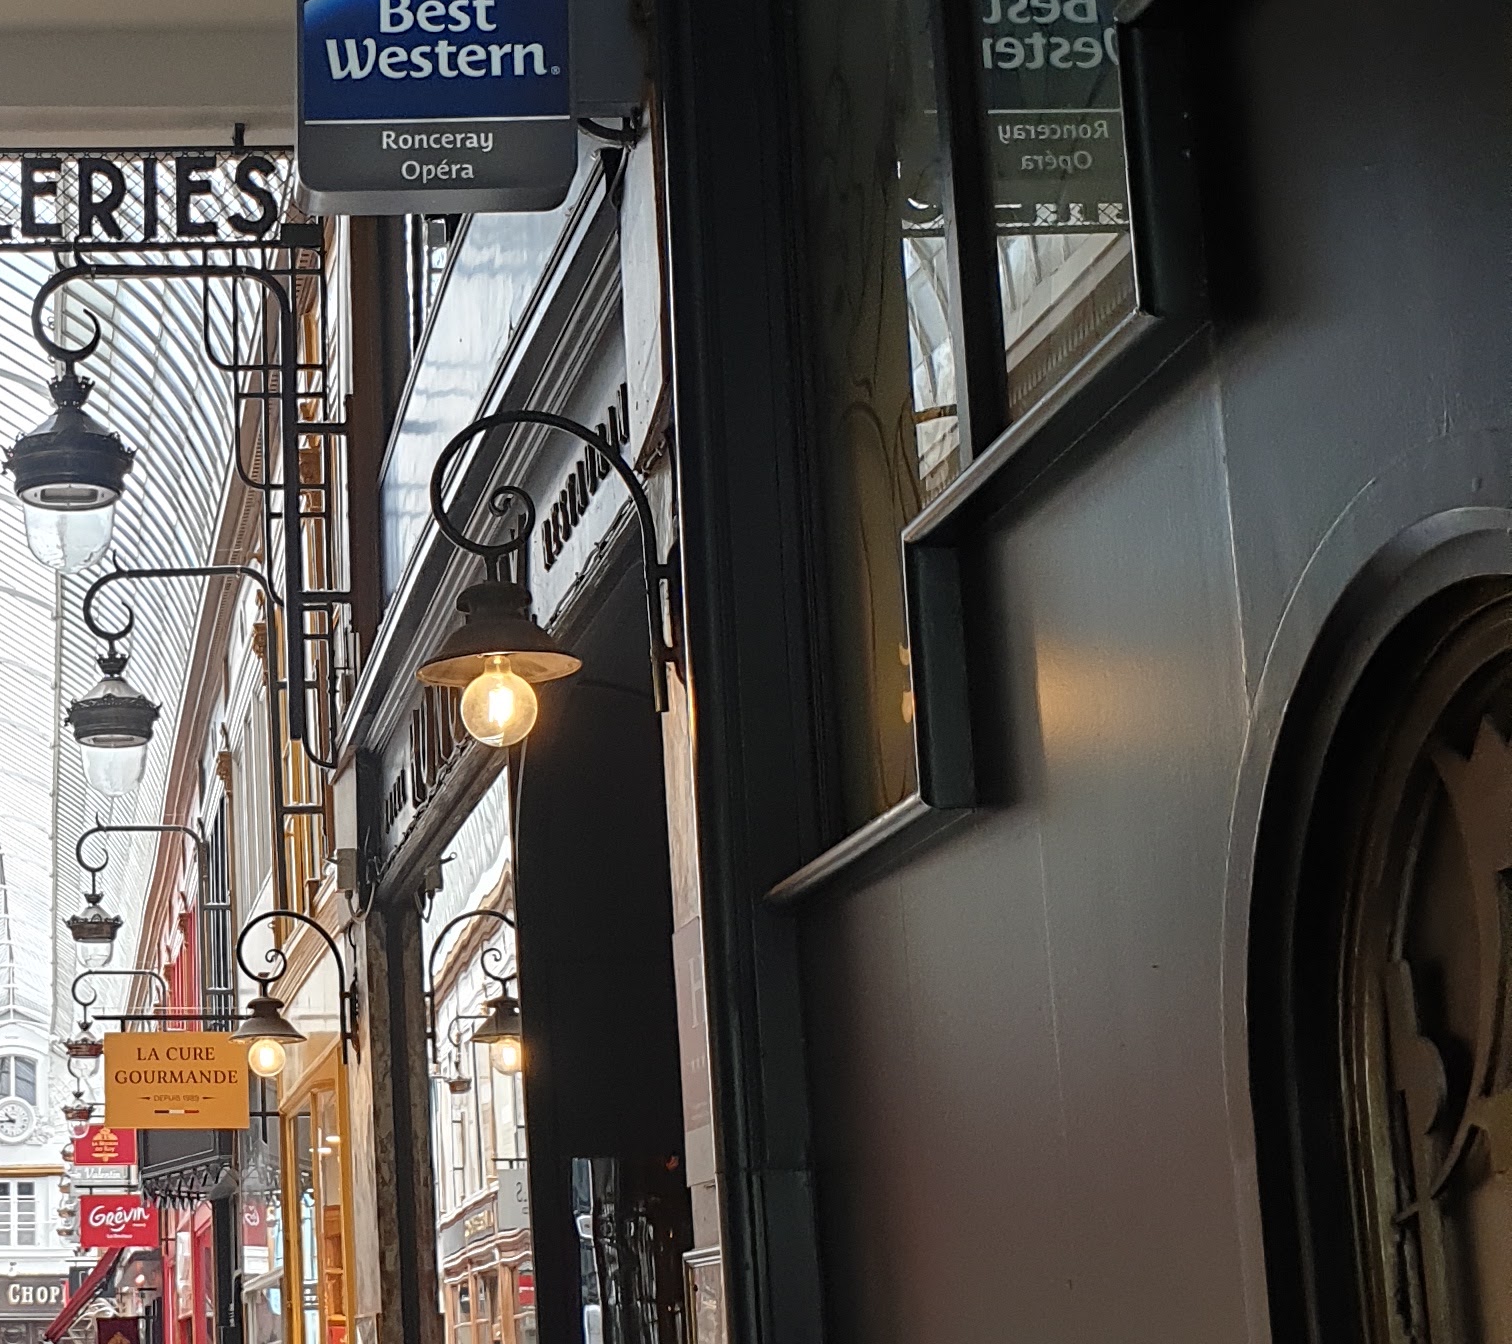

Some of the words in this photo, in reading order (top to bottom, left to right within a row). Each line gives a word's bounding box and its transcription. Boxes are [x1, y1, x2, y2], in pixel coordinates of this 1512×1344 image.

[325, 37, 548, 80] Western
[381, 130, 494, 152] Ronceray
[401, 159, 475, 183] Opéra
[136, 1047, 159, 1061] LA
[166, 1046, 216, 1061] CURE
[114, 1069, 238, 1085] GOURMANDE
[9, 1284, 66, 1304] CHOP
